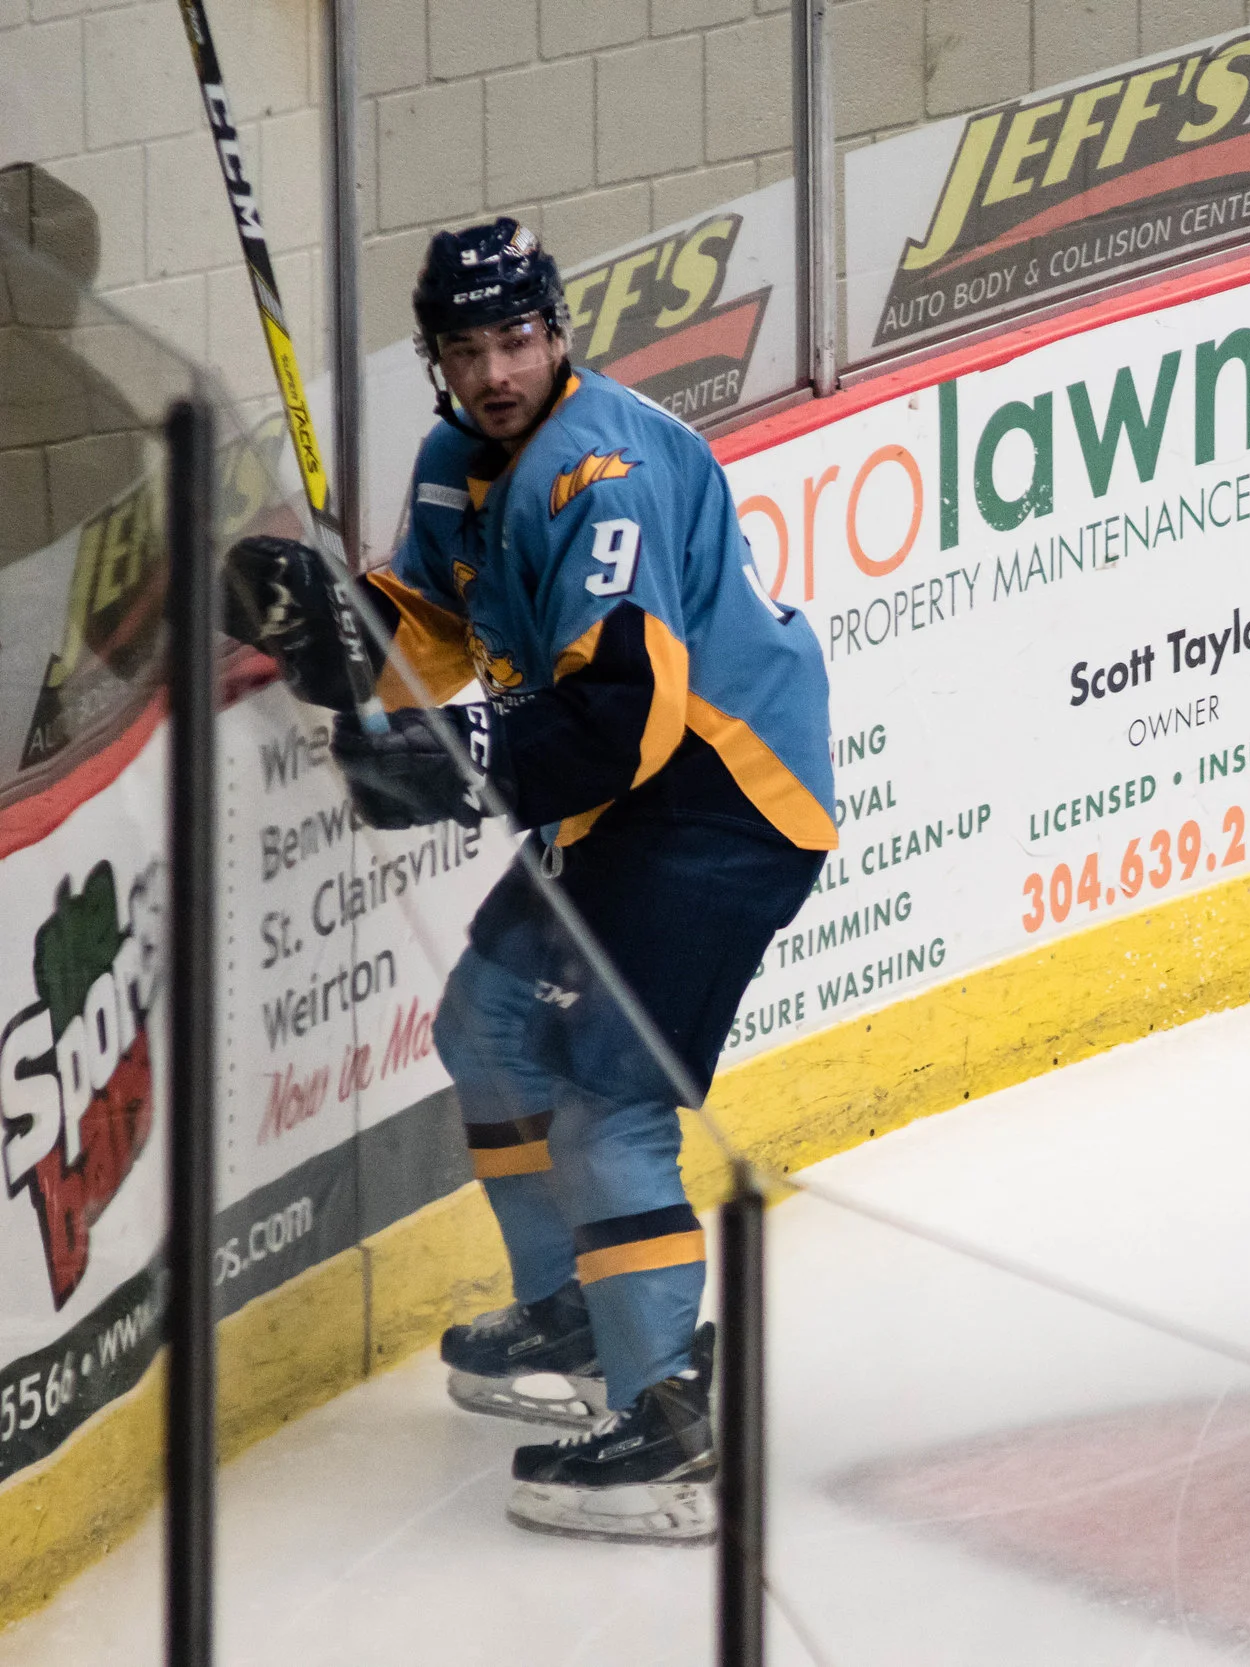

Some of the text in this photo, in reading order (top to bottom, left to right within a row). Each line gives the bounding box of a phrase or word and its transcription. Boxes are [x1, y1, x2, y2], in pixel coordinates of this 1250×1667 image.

[204, 83, 264, 239] CCM
[453, 284, 501, 304] CCM
[883, 293, 945, 335] AUTO
[953, 274, 1016, 311] BODY
[1024, 260, 1040, 286] &
[1049, 215, 1171, 278] COLLISION
[288, 400, 319, 474] TACKS
[586, 519, 640, 597] 9
[829, 561, 981, 662] PROPERTY
[1070, 646, 1153, 706] Scott
[1128, 695, 1220, 748] OWNER
[861, 803, 992, 876] CLEAN-UP
[1029, 774, 1157, 842] LICENSED
[260, 824, 481, 969] St. Clairsville
[777, 891, 912, 968] TRIMMING
[261, 949, 398, 1051] Weirton
[724, 937, 946, 1052] SSURE WASHING
